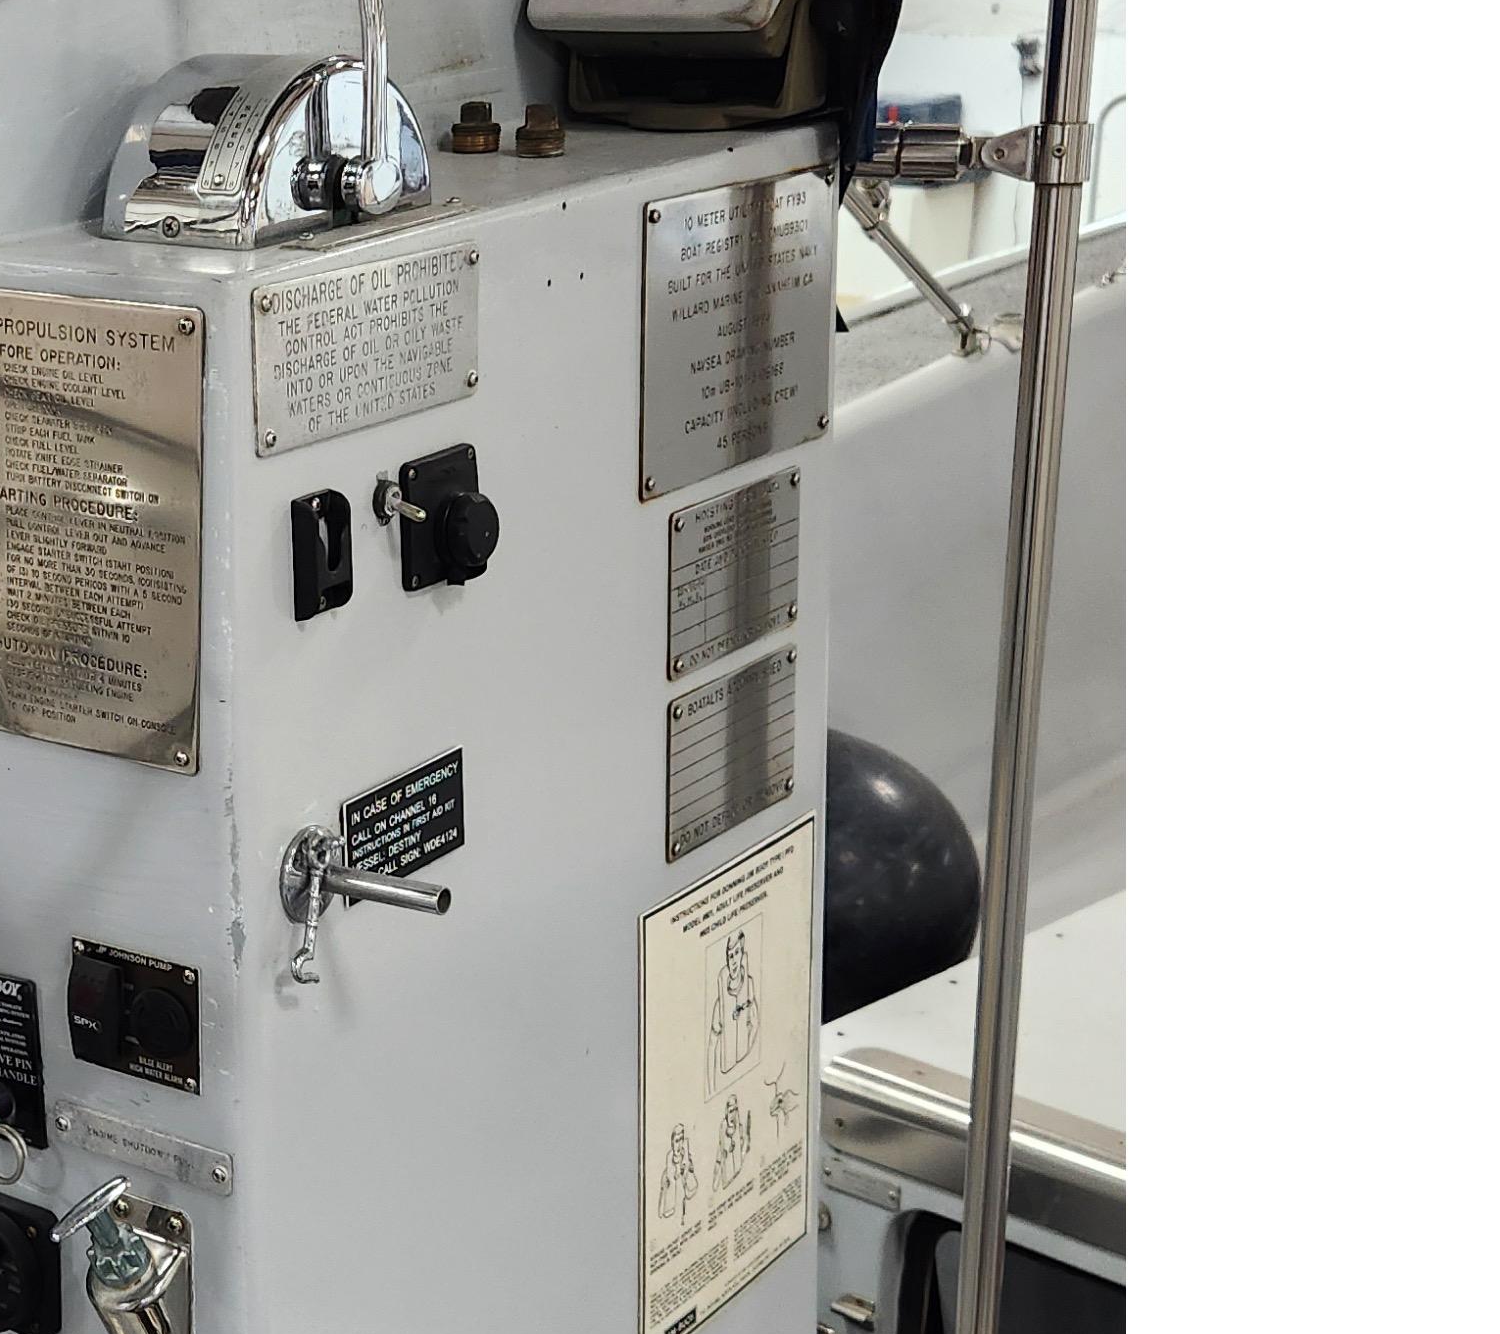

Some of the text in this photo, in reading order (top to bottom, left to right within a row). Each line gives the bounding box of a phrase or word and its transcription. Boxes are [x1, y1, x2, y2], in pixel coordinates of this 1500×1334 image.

[697, 210, 724, 228] METER
[787, 190, 806, 207] FY93
[681, 244, 701, 261] BOAT
[272, 250, 463, 314] DISCHARGE OF OIL PROHIBITED
[668, 276, 690, 295] BUILT
[696, 270, 711, 287] FOR
[716, 265, 730, 282] THE
[279, 279, 459, 336] THE FEDERAL WATER POLLUTION
[672, 300, 709, 322] WILLARD
[804, 271, 813, 285] CA
[106, 329, 175, 352] SYSTEM
[285, 300, 447, 356] CONTROL ACT PROHIBITS THE
[40, 348, 120, 371] OPERATION:
[274, 315, 463, 380] DISCHARGE OF OIL OR OILY WASTE
[4, 363, 103, 383] CHECK ENGINE OIL LEVEL
[287, 338, 452, 397] INTO OR UPON THE NAVIGABLE
[4, 375, 27, 386] CHECK
[63, 382, 97, 395] COOLANT
[102, 387, 125, 399] LEVEL
[288, 392, 330, 418] WATERS
[337, 386, 351, 404] OR
[427, 357, 452, 378] ZONE
[309, 415, 322, 432] OF
[328, 407, 349, 426] THE
[400, 382, 435, 404] STATES
[5, 435, 78, 454] CHECK FUEL LEVEL
[54, 495, 138, 522] PROCEDURE:
[115, 489, 144, 502] SWITCH
[93, 533, 165, 553] OUT AND ADVANCE
[117, 621, 151, 635] ATTEMPT
[62, 649, 147, 680] PROCEDURE:
[351, 761, 458, 826] IN CASE OF EMERGENCY
[352, 794, 436, 846] CALL ON CHANNEL 16
[352, 799, 455, 860] INSTRUCTIONS IN FIRST AID KIT
[378, 827, 457, 876] CALL SIGN: WDE4124
[388, 831, 421, 857] DESTINY
[109, 949, 173, 971] JOHNSON PUMP
[74, 1015, 98, 1031] SPX
[15, 1058, 32, 1071] PIN
